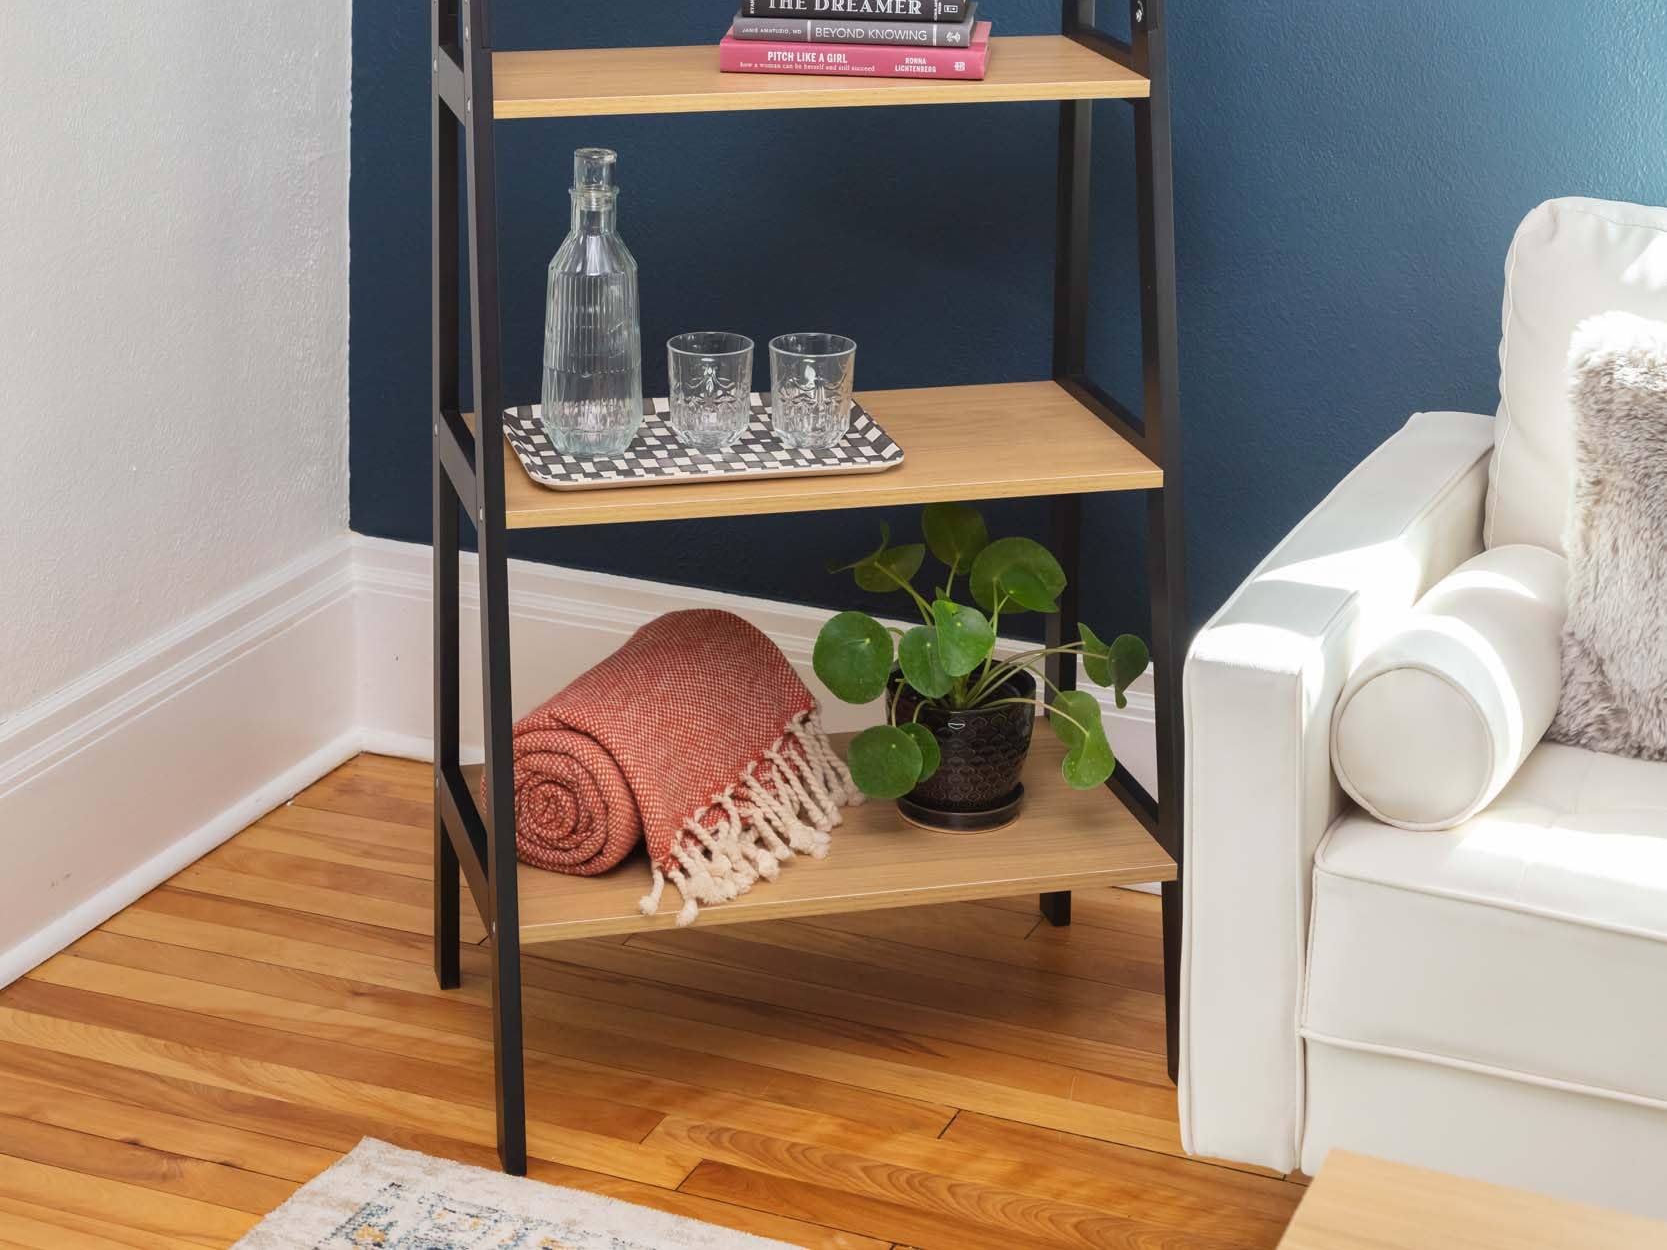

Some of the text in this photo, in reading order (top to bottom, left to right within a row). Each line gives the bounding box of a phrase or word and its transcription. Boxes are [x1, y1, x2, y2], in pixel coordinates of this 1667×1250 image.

[815, 27, 928, 41] BEYOND KNOWING
[767, 51, 848, 63] PITCH LIKE A GIRL
